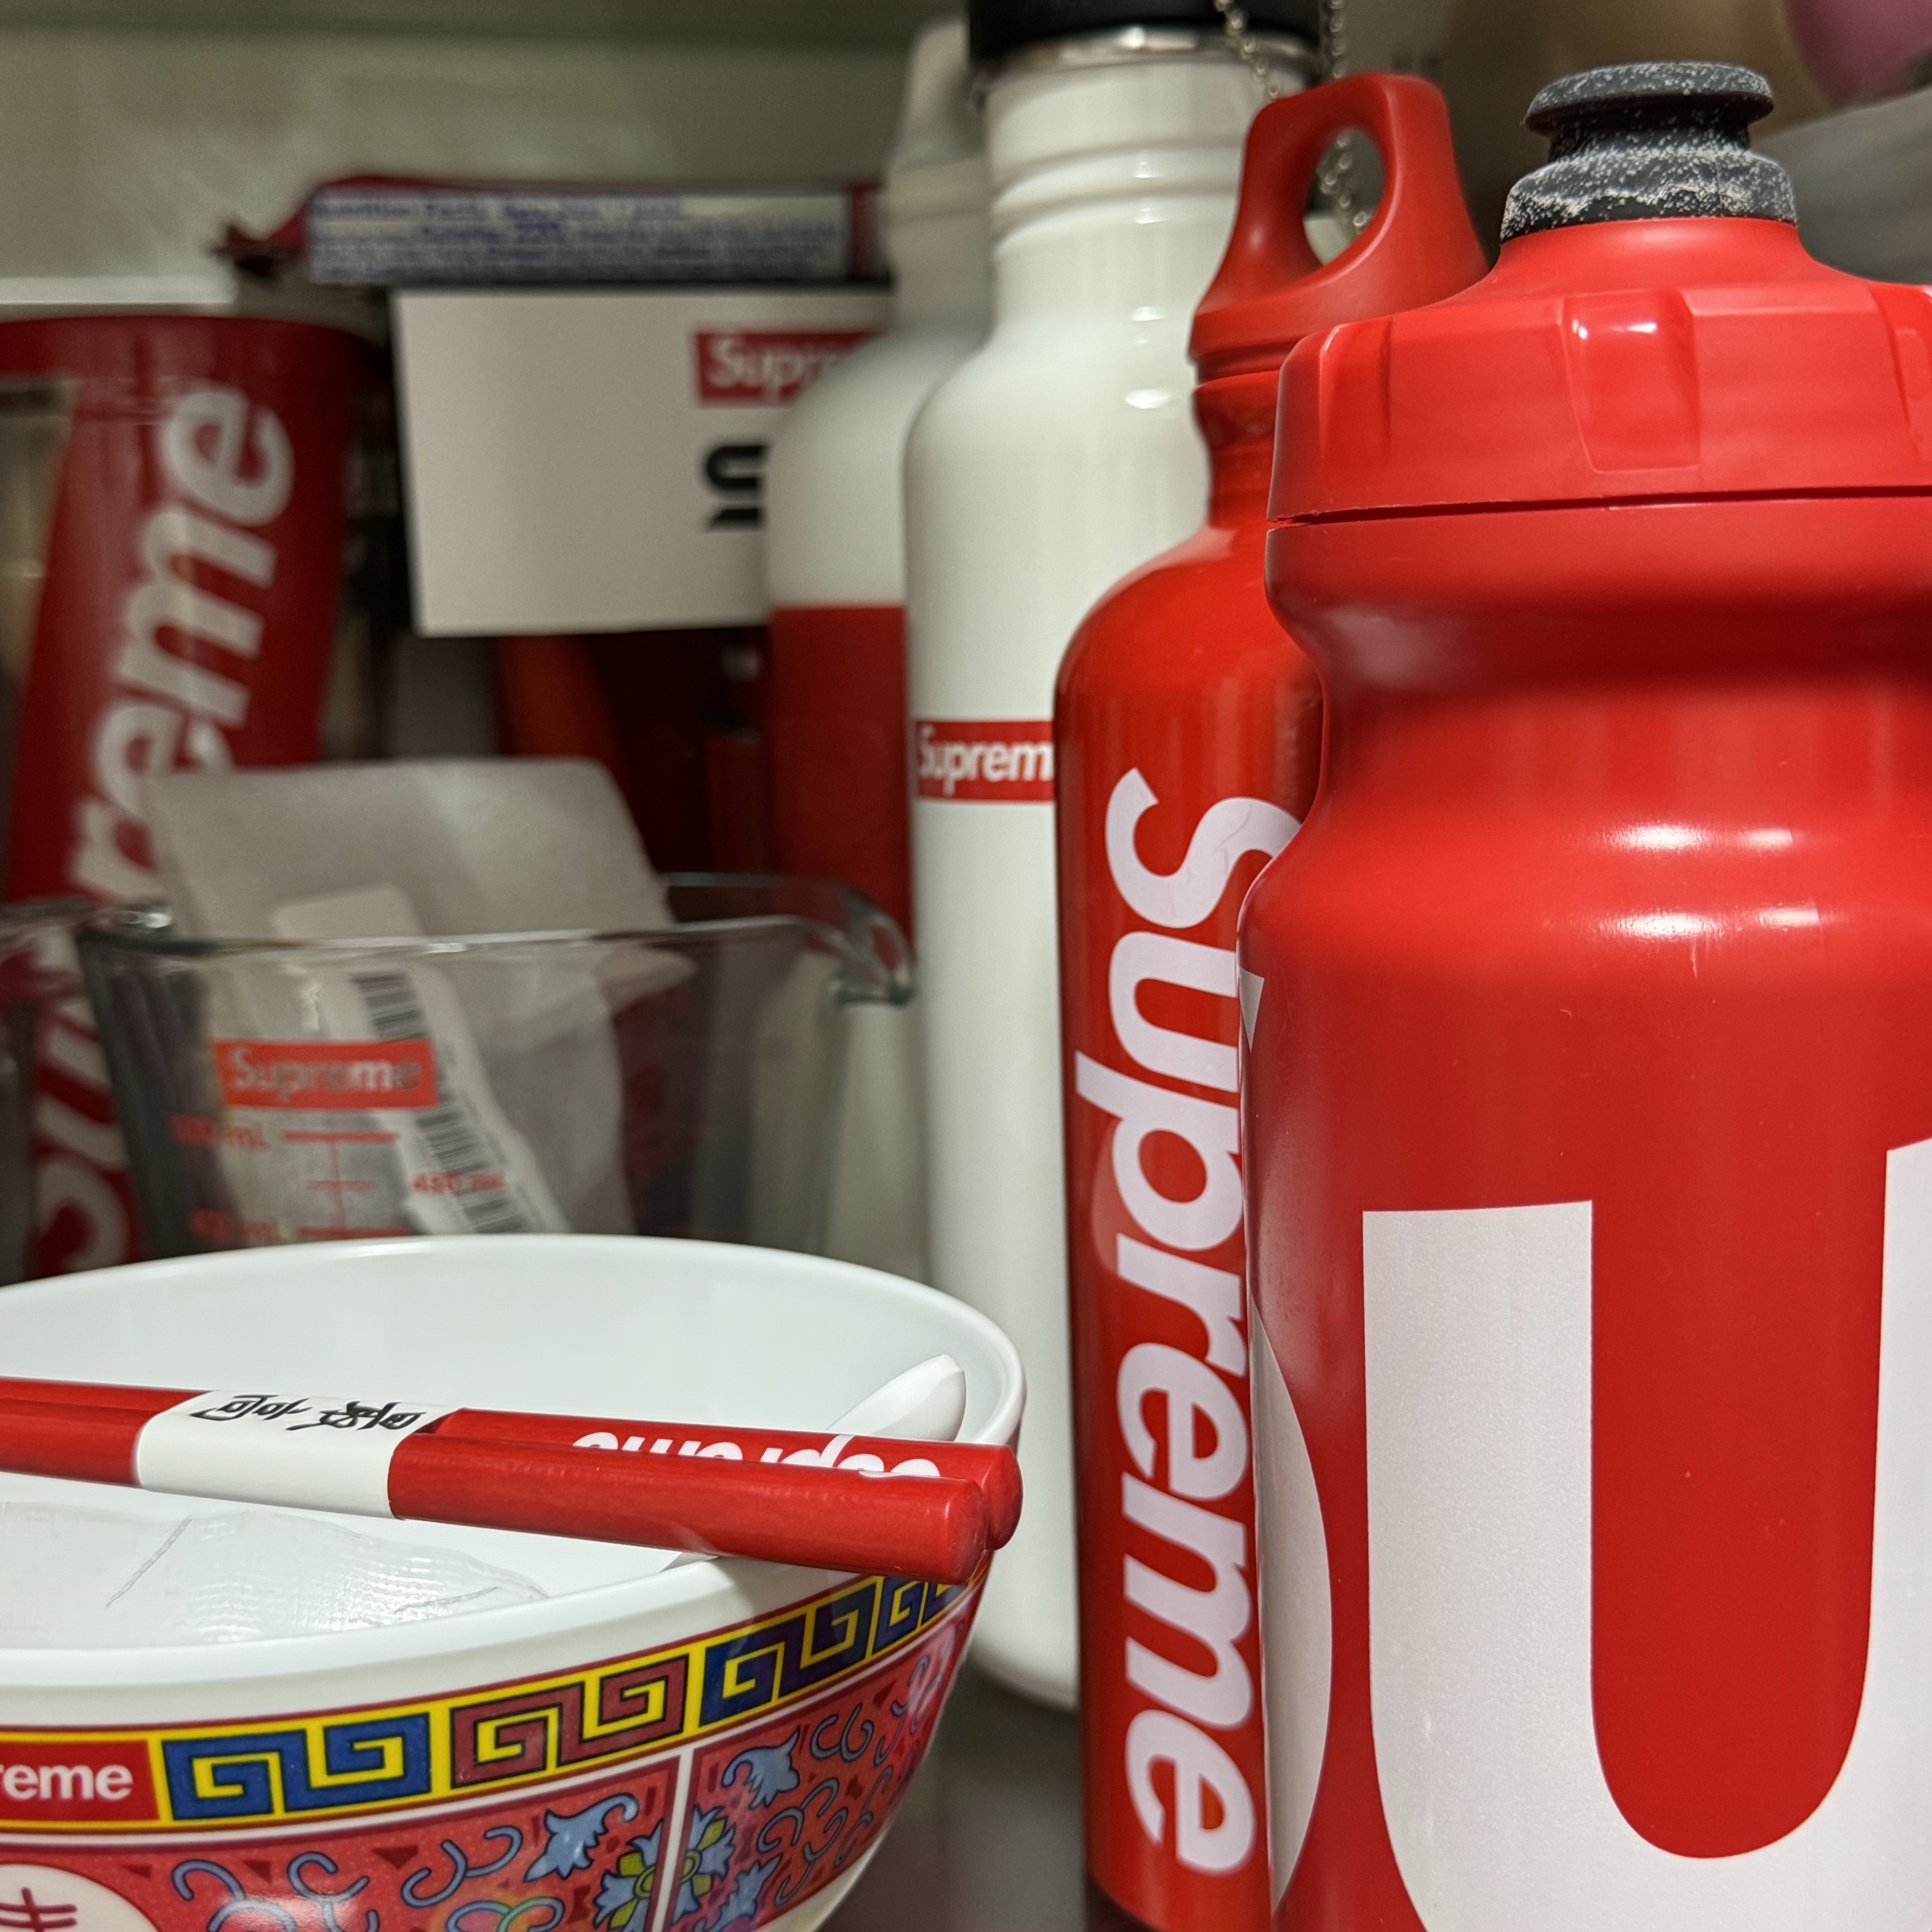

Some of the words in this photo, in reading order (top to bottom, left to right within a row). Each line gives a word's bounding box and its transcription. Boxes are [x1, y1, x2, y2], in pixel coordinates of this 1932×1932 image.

[34, 386, 296, 1268] ureme
[230, 1045, 420, 1103] Supreme
[1075, 767, 1304, 1874] Supreme
[0, 1764, 133, 1801] eme
